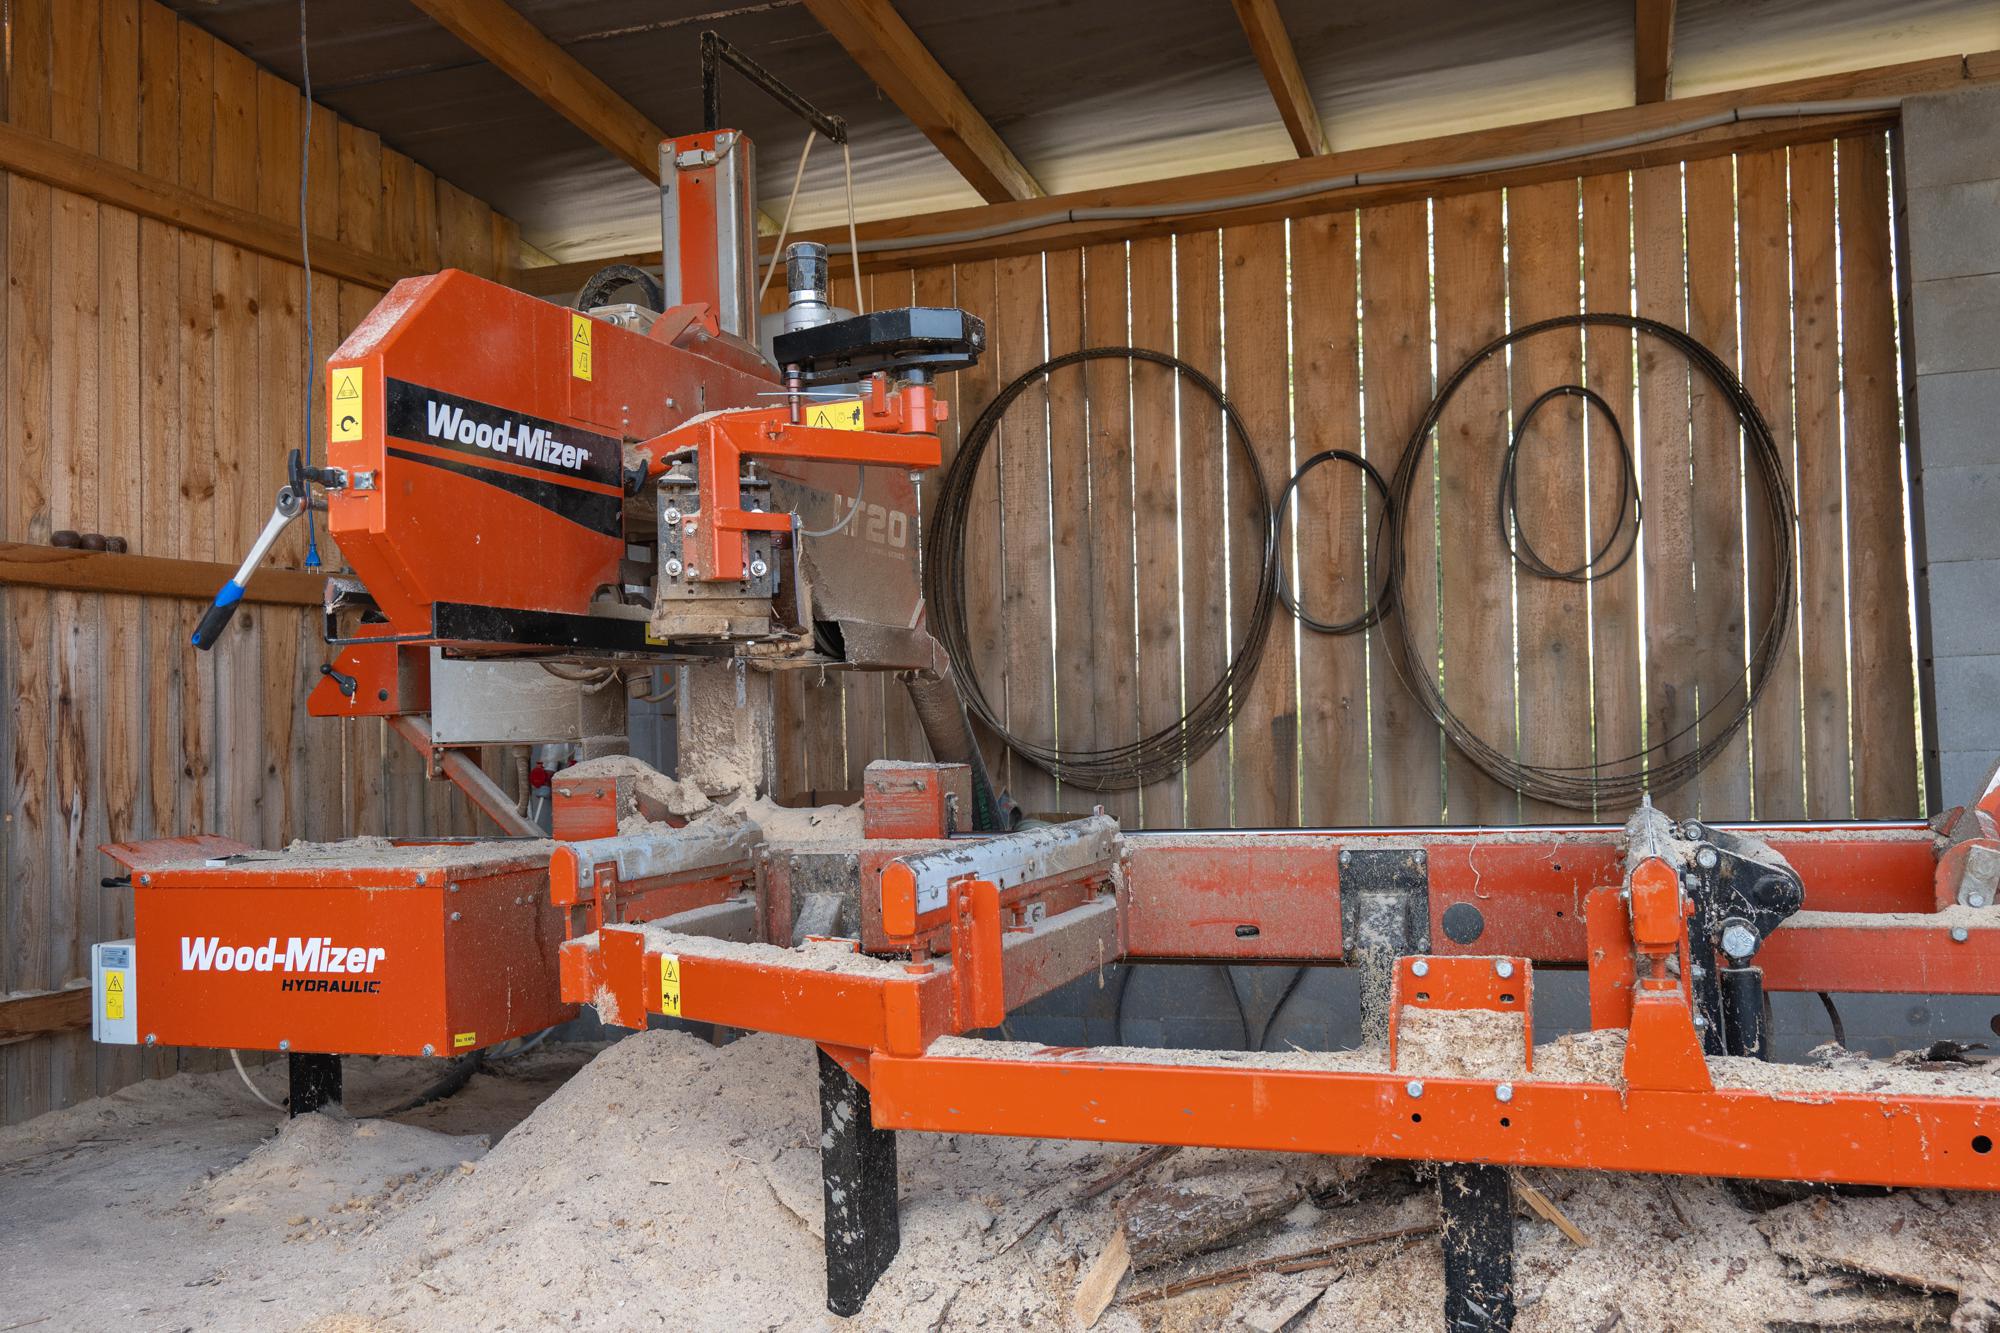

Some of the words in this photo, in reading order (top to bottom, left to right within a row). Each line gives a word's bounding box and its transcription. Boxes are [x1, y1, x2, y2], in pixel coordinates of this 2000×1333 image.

[427, 400, 589, 471] Wood-Mizer
[181, 937, 386, 973] Wood-Mizer
[281, 979, 381, 993] HYDRAULIC
